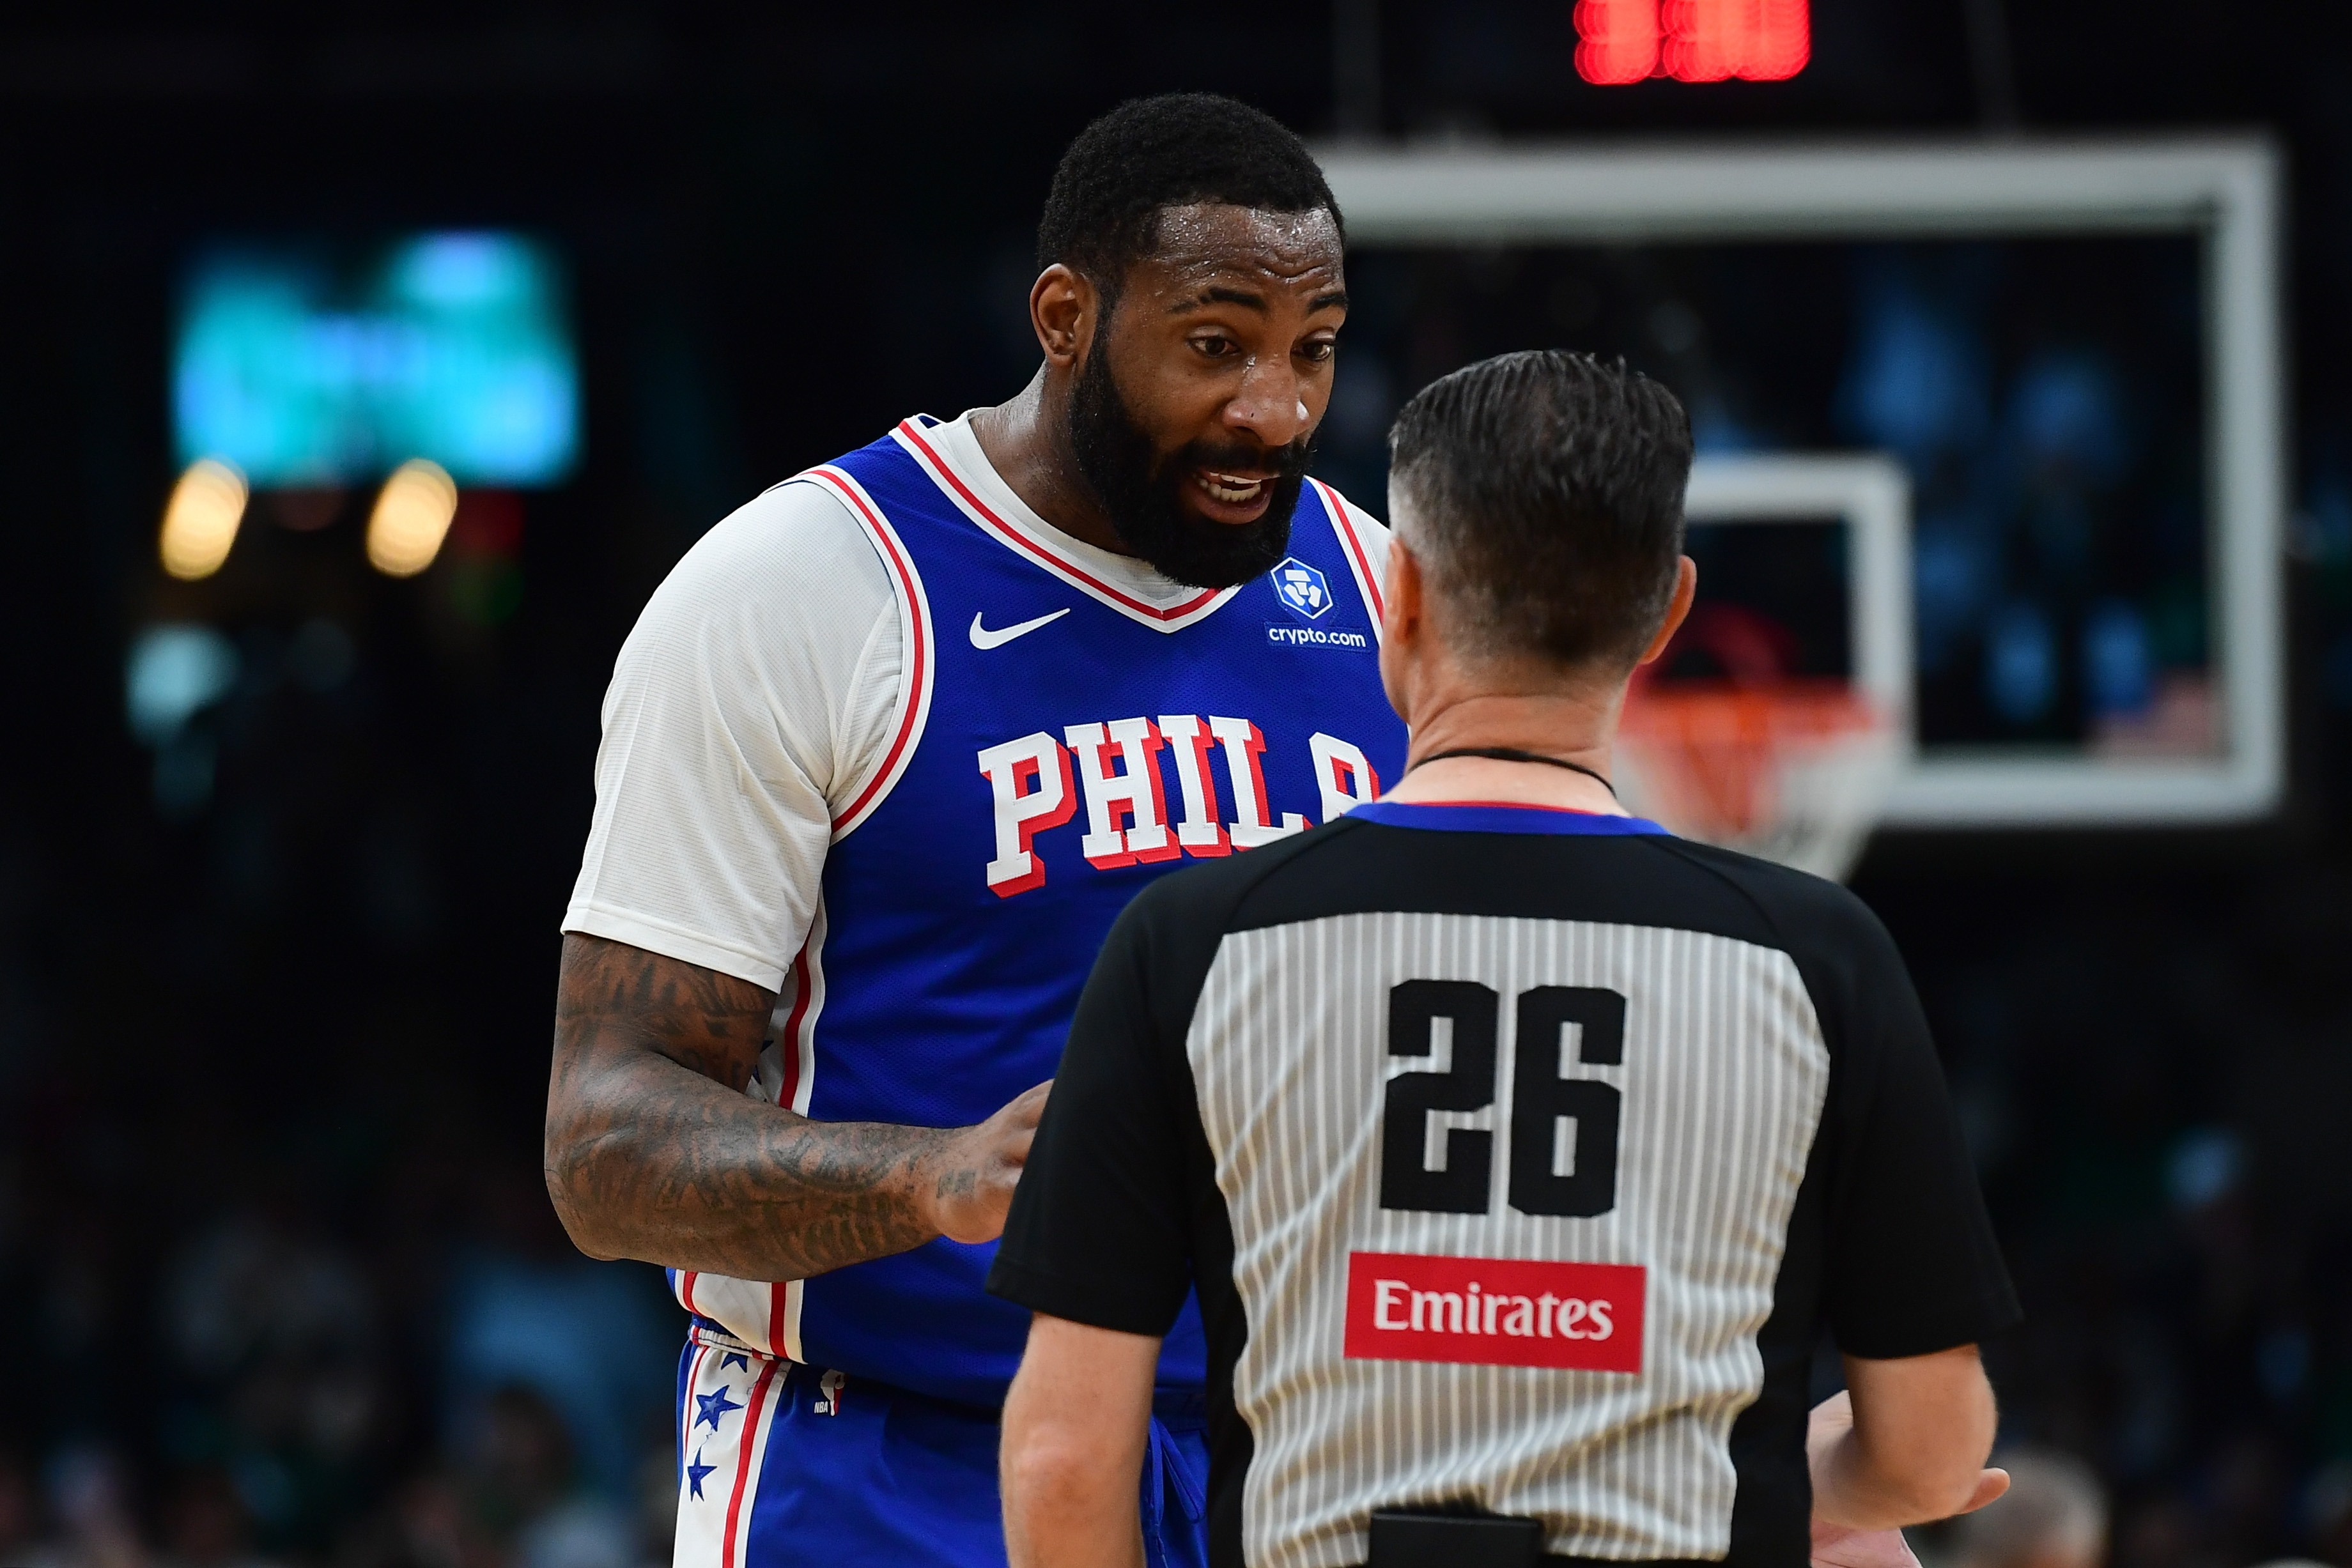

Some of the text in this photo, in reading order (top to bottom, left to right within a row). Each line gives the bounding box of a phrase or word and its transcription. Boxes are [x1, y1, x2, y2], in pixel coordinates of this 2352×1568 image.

[1269, 627, 1366, 647] crypto.com
[1380, 979, 1627, 1218] 26
[1374, 1279, 1614, 1341] Emirates
[814, 1401, 828, 1414] NBA
